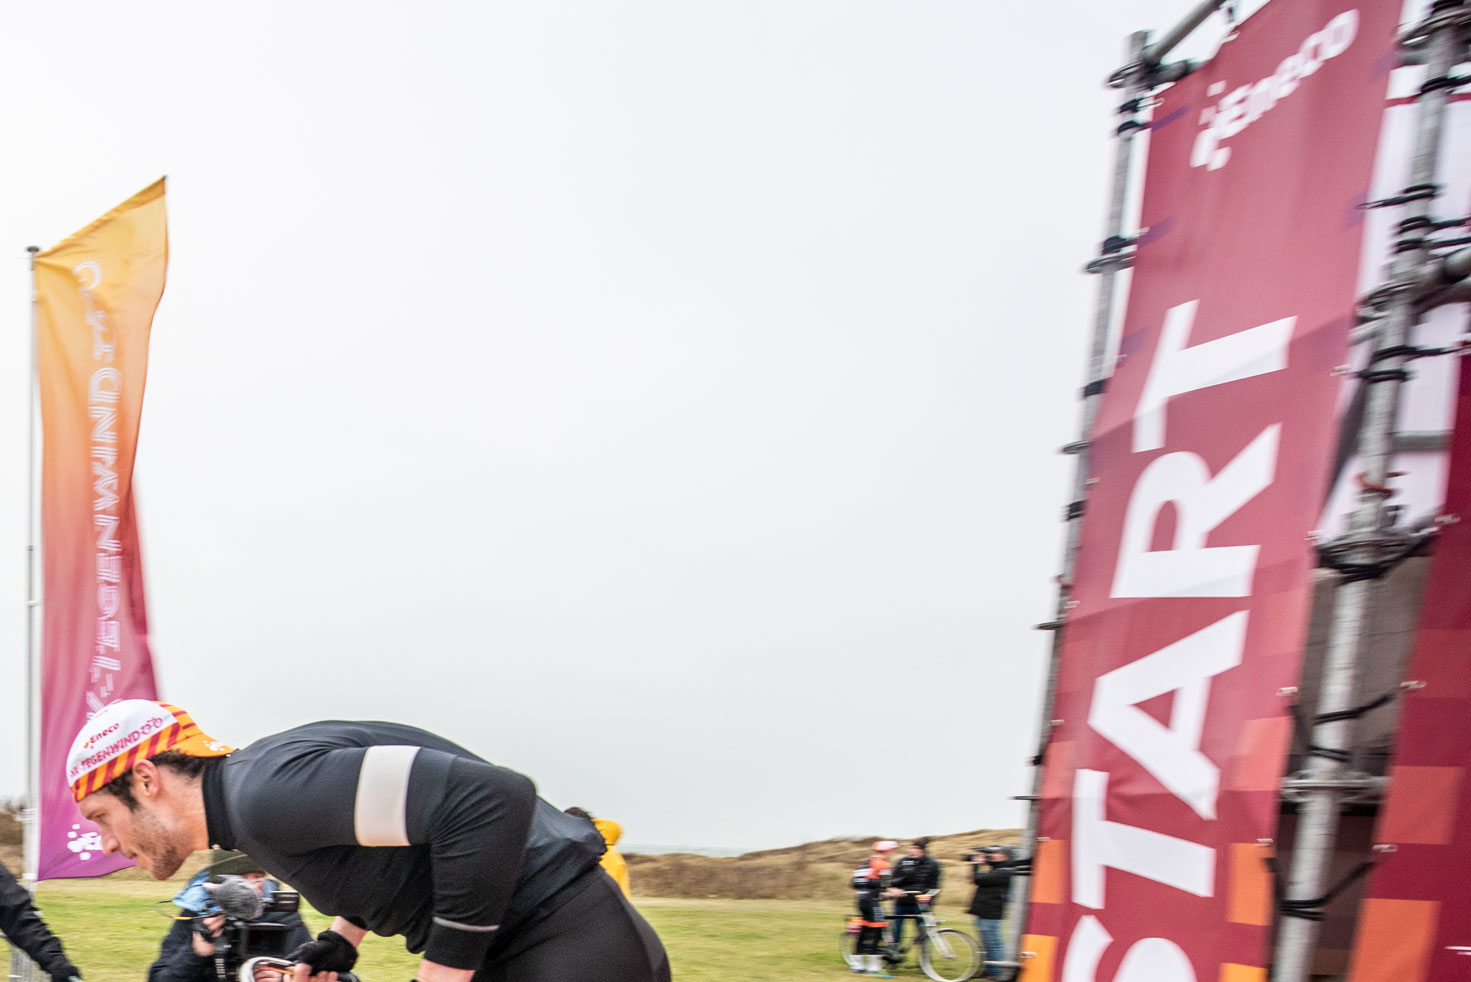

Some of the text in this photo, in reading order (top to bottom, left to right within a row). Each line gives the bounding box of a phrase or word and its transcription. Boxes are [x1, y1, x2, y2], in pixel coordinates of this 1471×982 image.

[1209, 8, 1360, 140] Eneco
[81, 729, 142, 771] TEGENWIND
[90, 722, 121, 744] Eneco
